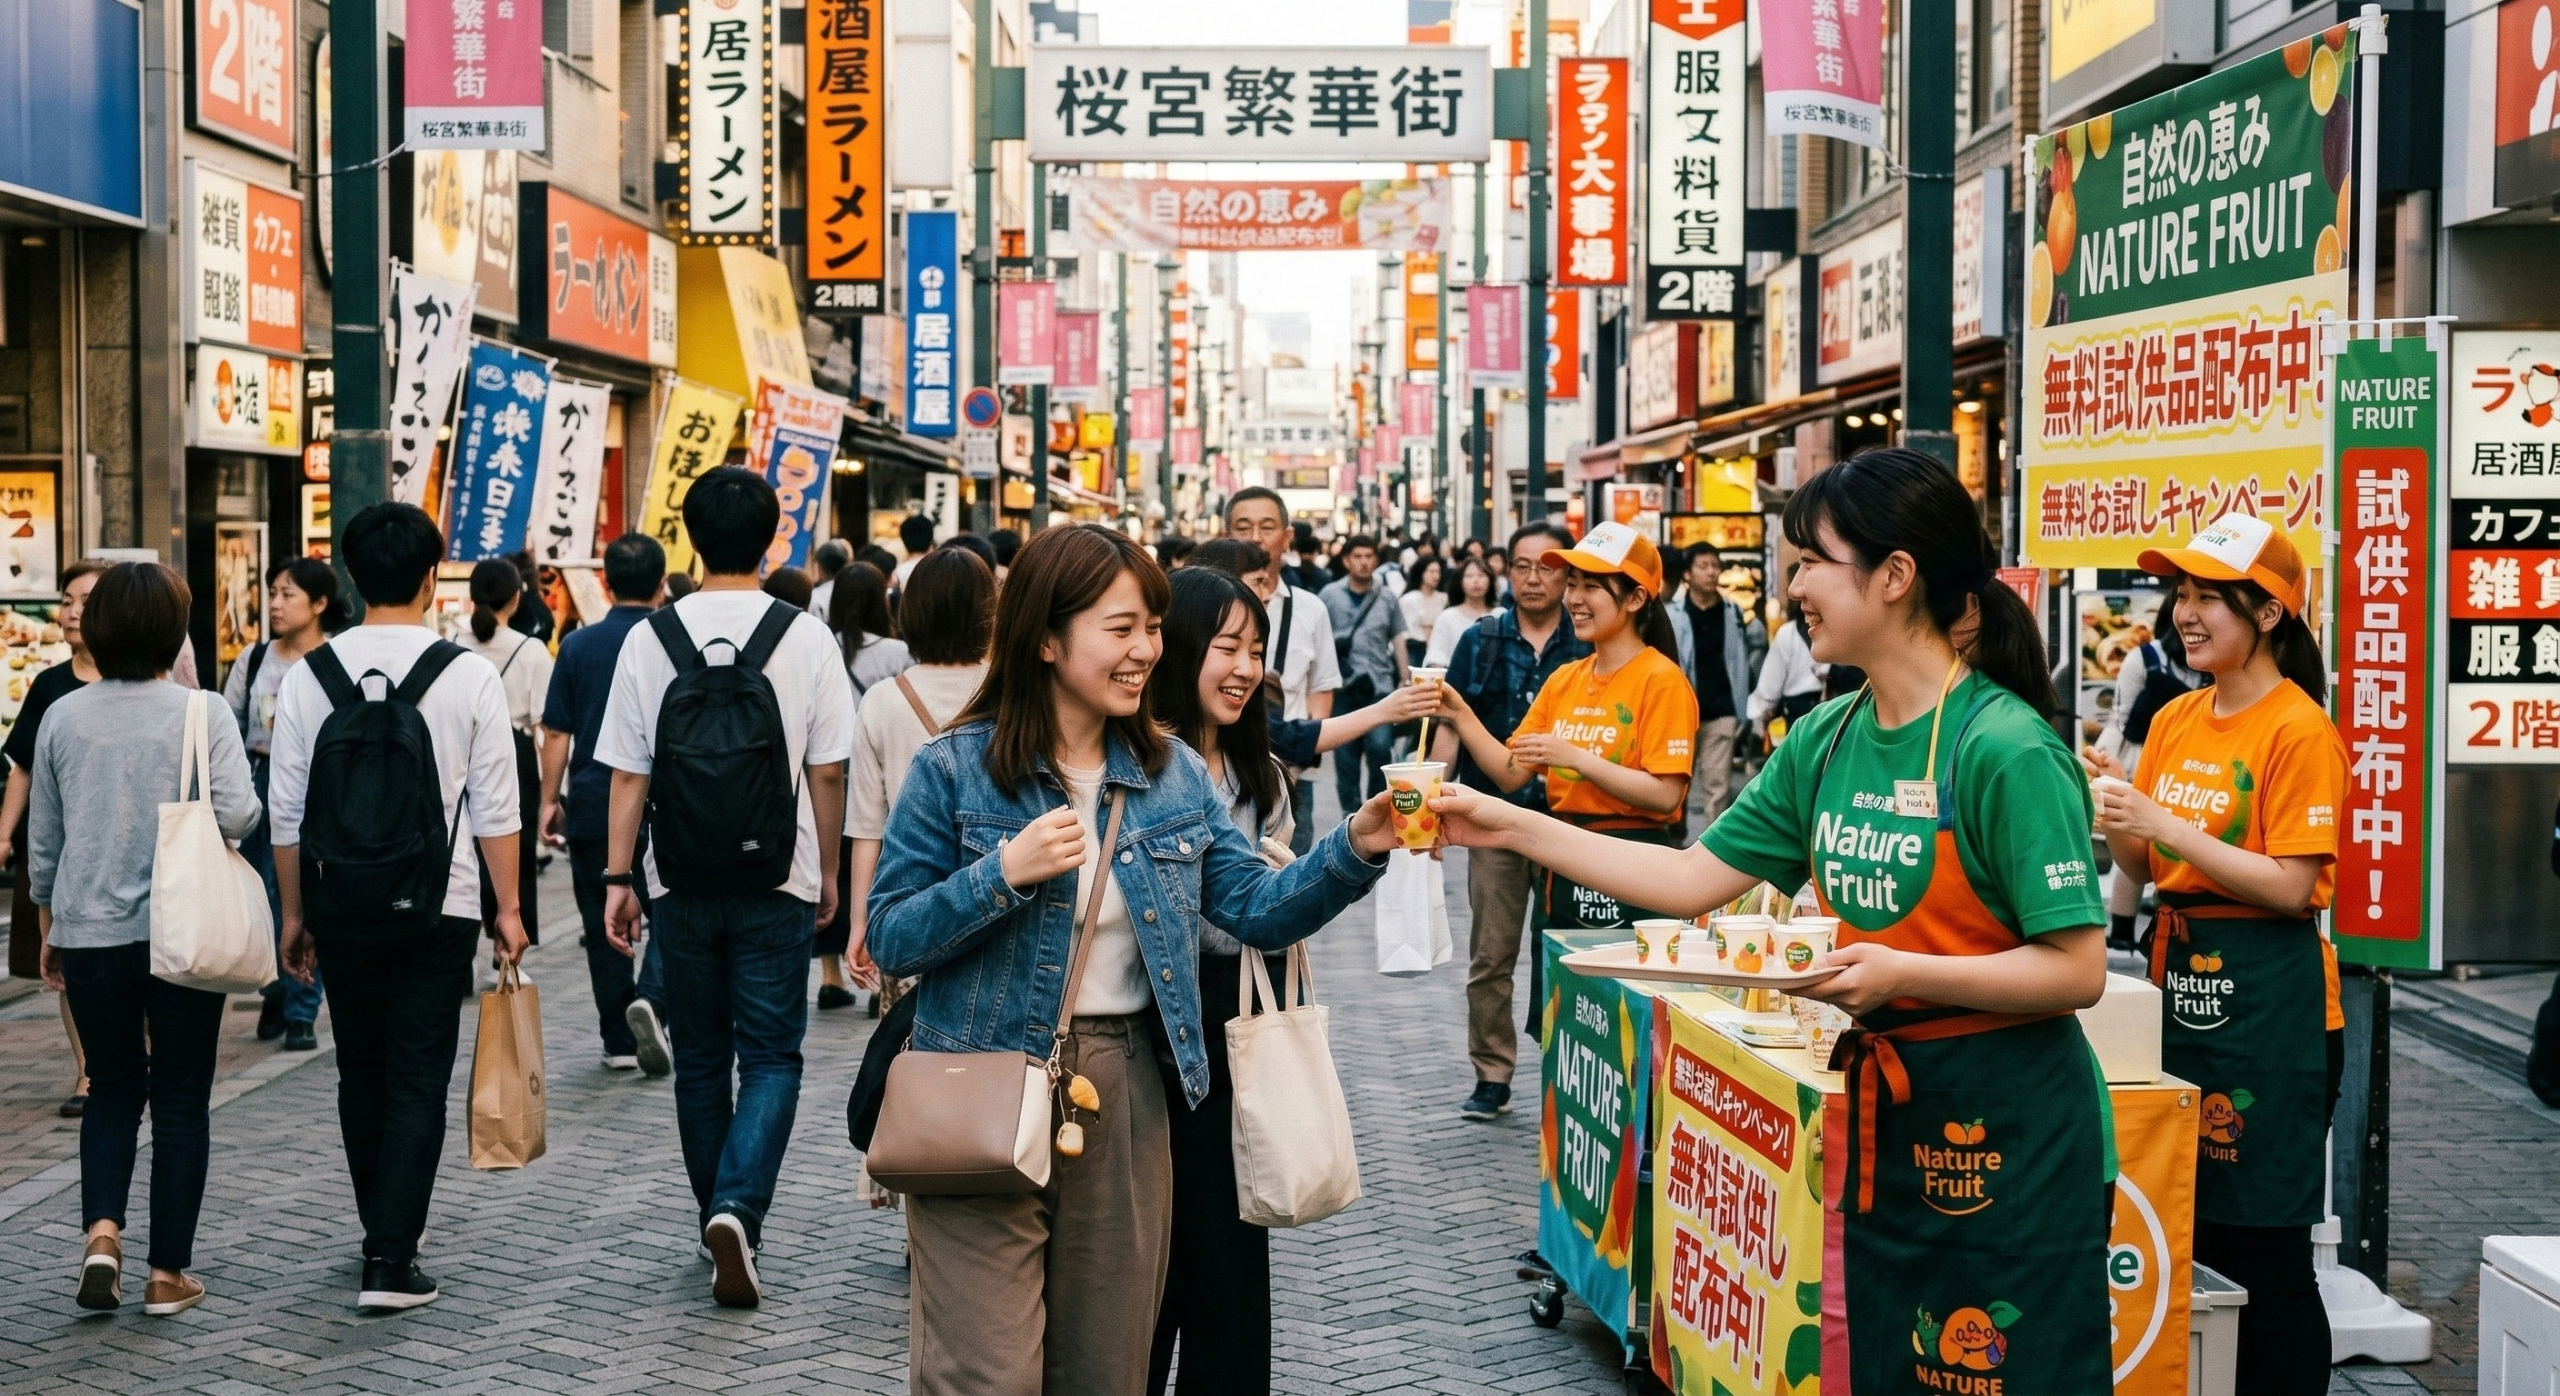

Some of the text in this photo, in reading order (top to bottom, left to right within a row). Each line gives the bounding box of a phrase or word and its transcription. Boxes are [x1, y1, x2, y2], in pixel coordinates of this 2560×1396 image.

[702, 20, 751, 223] 居ラーメン
[1056, 65, 1463, 137] 桜宮繁華街
[2122, 94, 2271, 209] 自然の恵み
[1150, 187, 1328, 223] 自然の恵み
[2079, 203, 2200, 297] NATURE
[2209, 171, 2312, 269] FRUIT
[1658, 271, 1735, 313] 2階
[914, 313, 951, 425] 居酒屋
[2341, 376, 2431, 403] NATURE
[2352, 406, 2418, 430] FRUIT
[2042, 473, 2323, 537] 無料お試しキャンペーン!
[2351, 468, 2410, 920] 試供品配布中!
[2151, 774, 2230, 815] Nature
[1815, 811, 1922, 867] Nature
[1580, 903, 1619, 920] Fruit
[1825, 860, 1899, 913] Fruit
[2167, 970, 2234, 994] Nature
[2174, 993, 2222, 1016] Fruit
[1557, 1028, 1623, 1139] NATURE
[1563, 1113, 1610, 1215] FRUIT
[1913, 1143, 2001, 1171] Nature
[1667, 1120, 1788, 1281] 無料試供し
[1924, 1171, 1985, 1198] Fruit
[1671, 1226, 1767, 1382] 配布中!
[1915, 1363, 2003, 1396] NATURE
